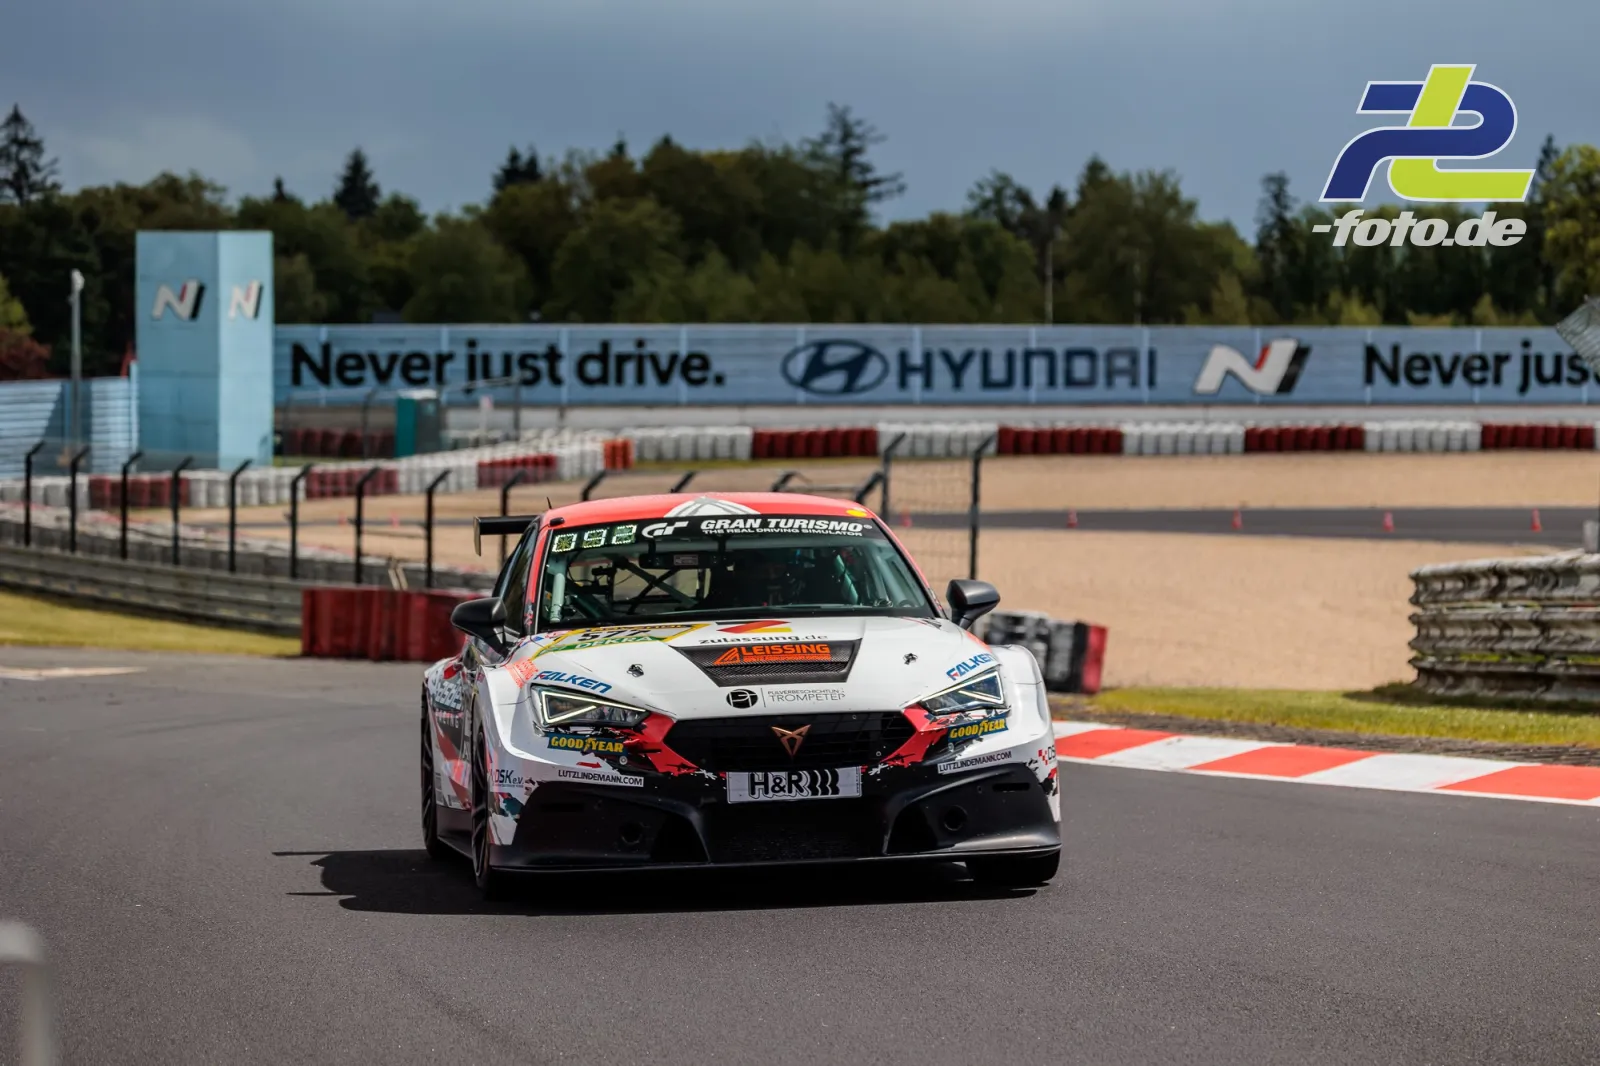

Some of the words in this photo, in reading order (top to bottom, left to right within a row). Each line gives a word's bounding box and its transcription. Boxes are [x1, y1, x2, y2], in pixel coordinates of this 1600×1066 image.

[290, 341, 454, 387] Never
[464, 338, 565, 393] just
[576, 339, 725, 387] drive.
[897, 347, 1158, 391] HYUNDAI
[1363, 342, 1510, 388] Never
[1517, 339, 1600, 396] jus
[700, 518, 761, 530] GRAN
[801, 528, 863, 537] SIMULATOR
[552, 524, 638, 553] 092
[575, 636, 655, 650] DEKRA
[699, 634, 829, 645] zulassung.de
[741, 643, 831, 656] LEISSING
[534, 670, 613, 694] FALKEN
[950, 718, 1007, 739] GOODYEAR
[551, 735, 625, 753] GOODYEAR
[939, 750, 1012, 772] LUTZLINDEMANN.COM
[558, 769, 643, 786] LUTZLINDEMANN.COM
[750, 770, 806, 797] H&R
